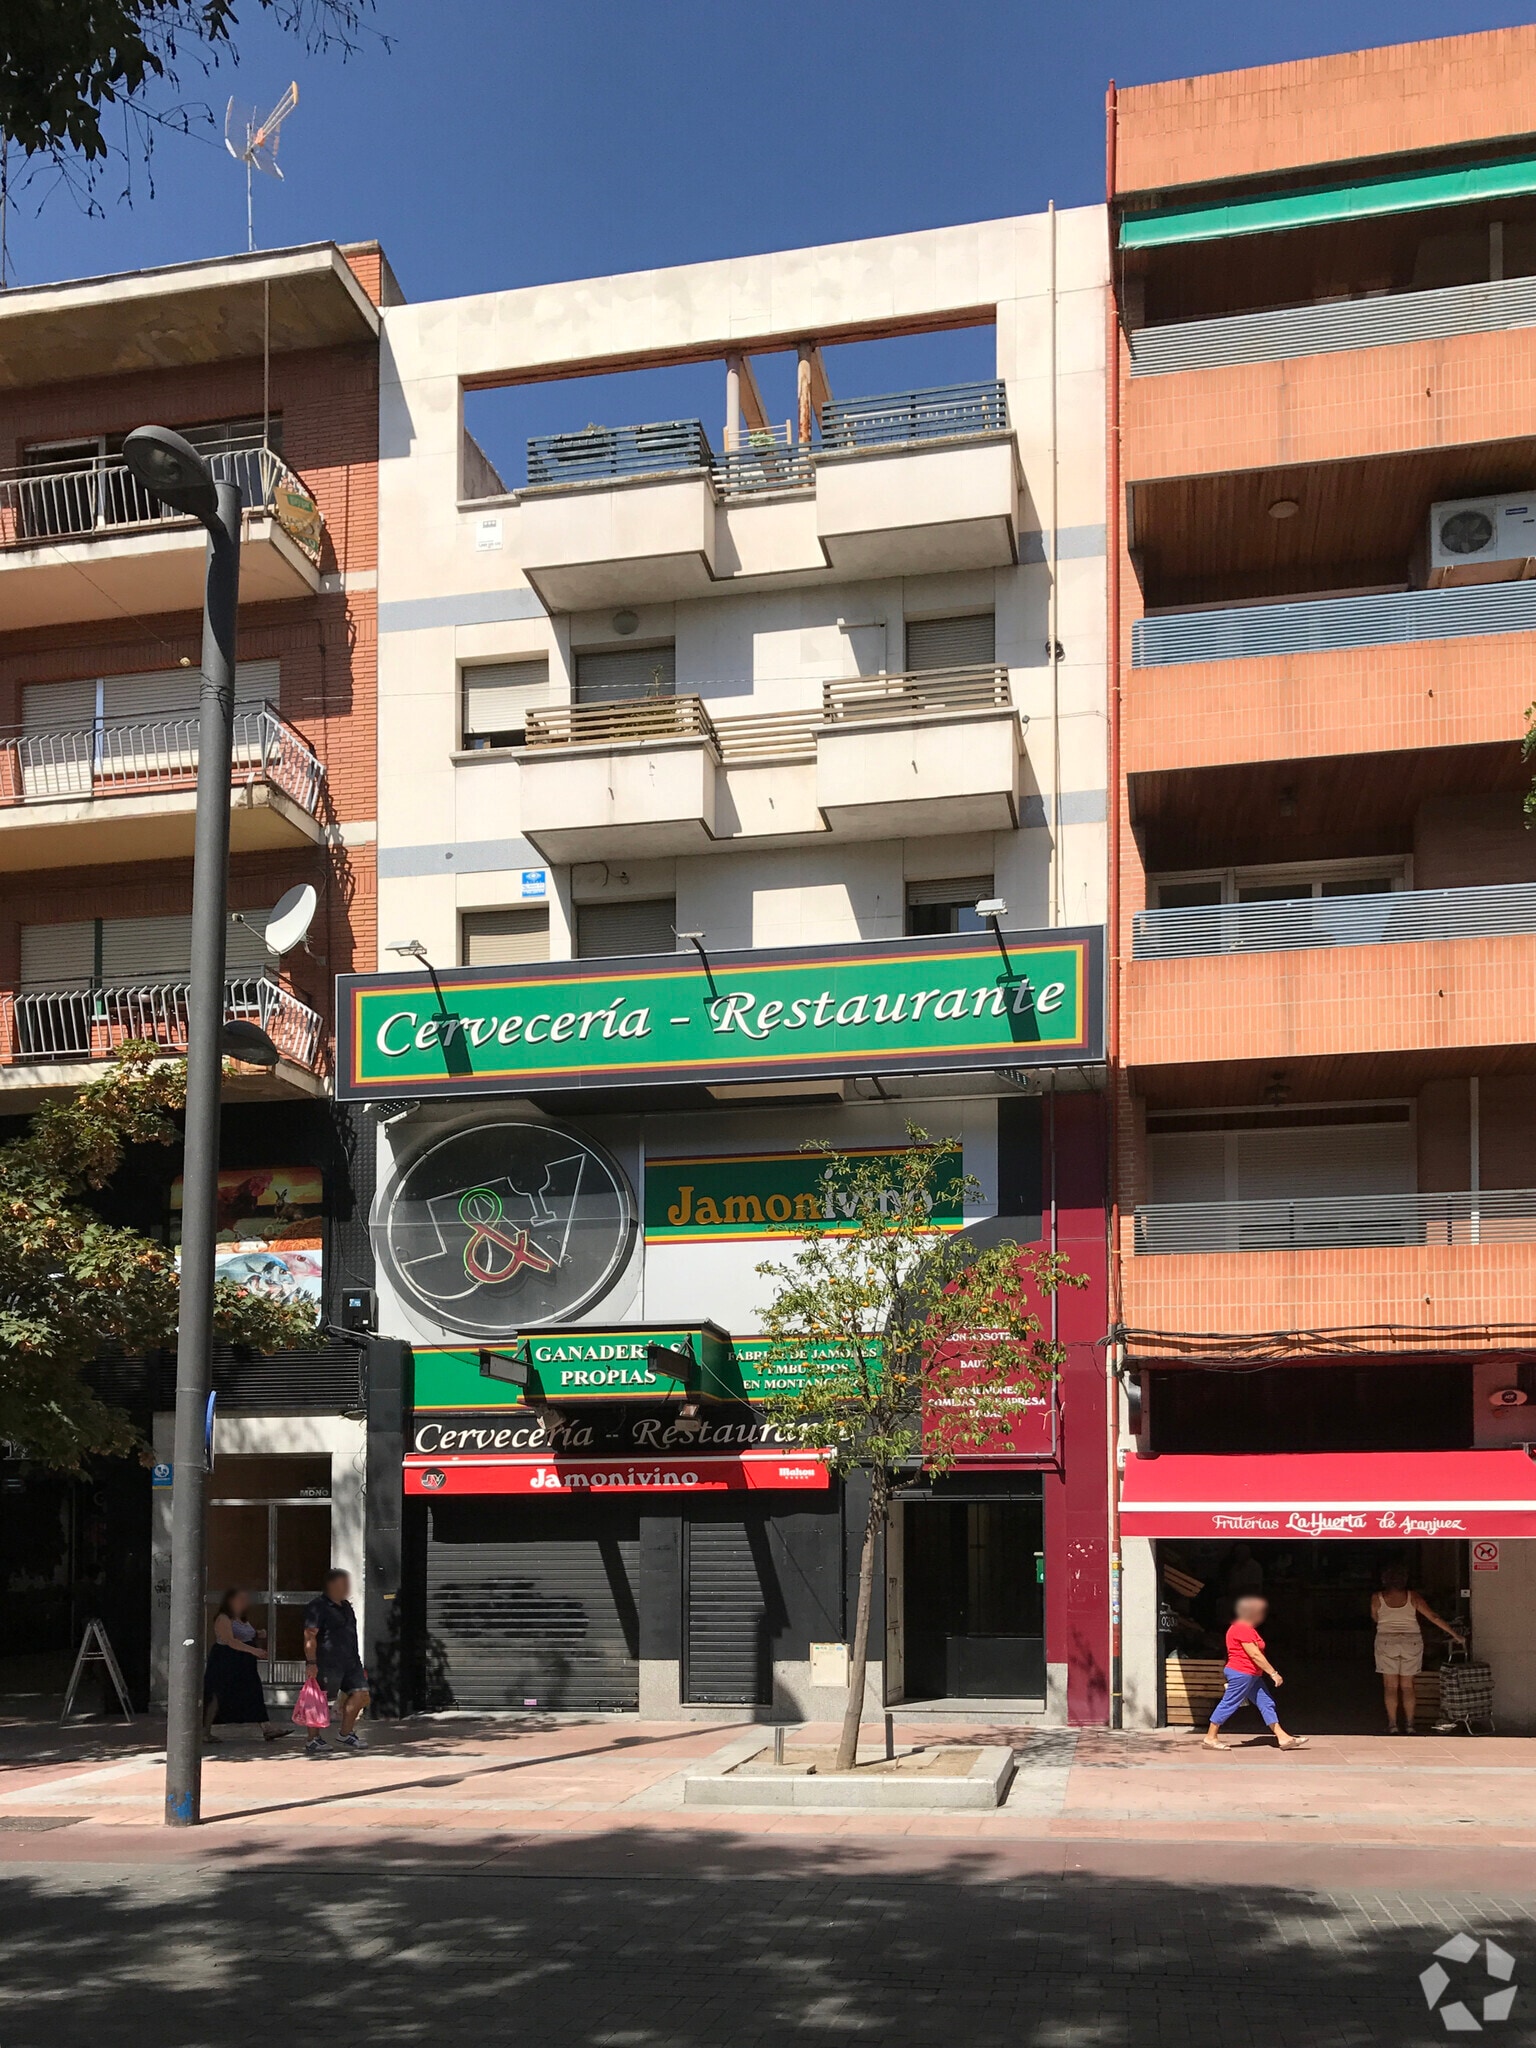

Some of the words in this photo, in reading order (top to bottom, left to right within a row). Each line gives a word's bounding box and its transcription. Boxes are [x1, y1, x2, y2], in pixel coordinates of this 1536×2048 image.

[376, 998, 652, 1057] Cervecería
[711, 977, 1066, 1040] Restaurante
[969, 1332, 1026, 1341] NSOTR
[535, 1341, 683, 1362] GANADERS
[728, 1349, 786, 1361] FÁBR
[790, 1350, 808, 1360] DE
[811, 1348, 877, 1360] JAMOES
[561, 1369, 657, 1386] PROPIAS
[767, 1364, 849, 1376] MBUDOS
[743, 1379, 760, 1390] EN
[415, 1420, 595, 1454] Cervecería
[632, 1418, 855, 1450] Restauran
[530, 1467, 699, 1490] Jamonivino
[778, 1468, 815, 1476] Mahou
[1212, 1515, 1279, 1530] Fruterías
[1376, 1511, 1396, 1530] de
[1398, 1515, 1467, 1535] Aranjuez
